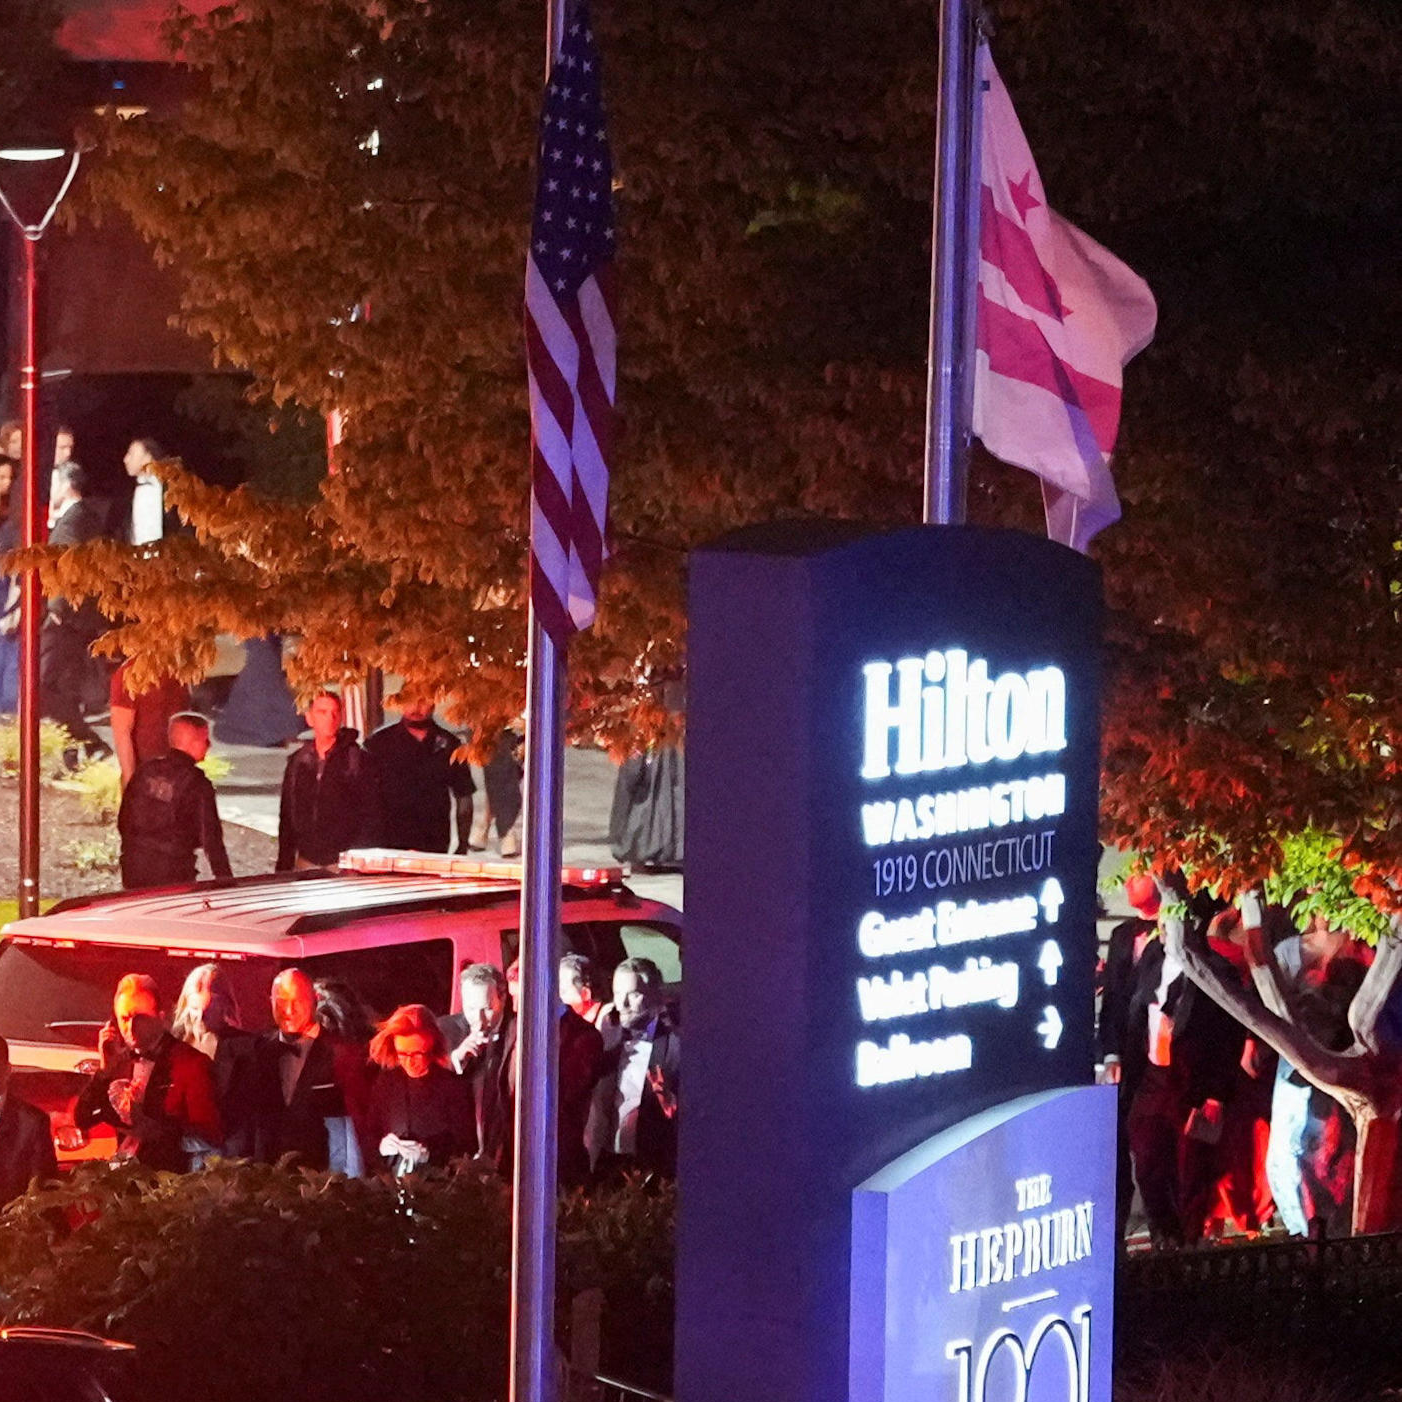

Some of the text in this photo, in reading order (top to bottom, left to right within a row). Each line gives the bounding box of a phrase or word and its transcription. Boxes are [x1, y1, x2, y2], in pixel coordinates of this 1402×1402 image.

[861, 648, 1067, 779] Hilton
[861, 773, 1065, 846] WASHINGTON
[873, 830, 1056, 897] 1919 CONNECTICUT
[1015, 1173, 1052, 1212] THE
[949, 1200, 1095, 1293] HEPBURN
